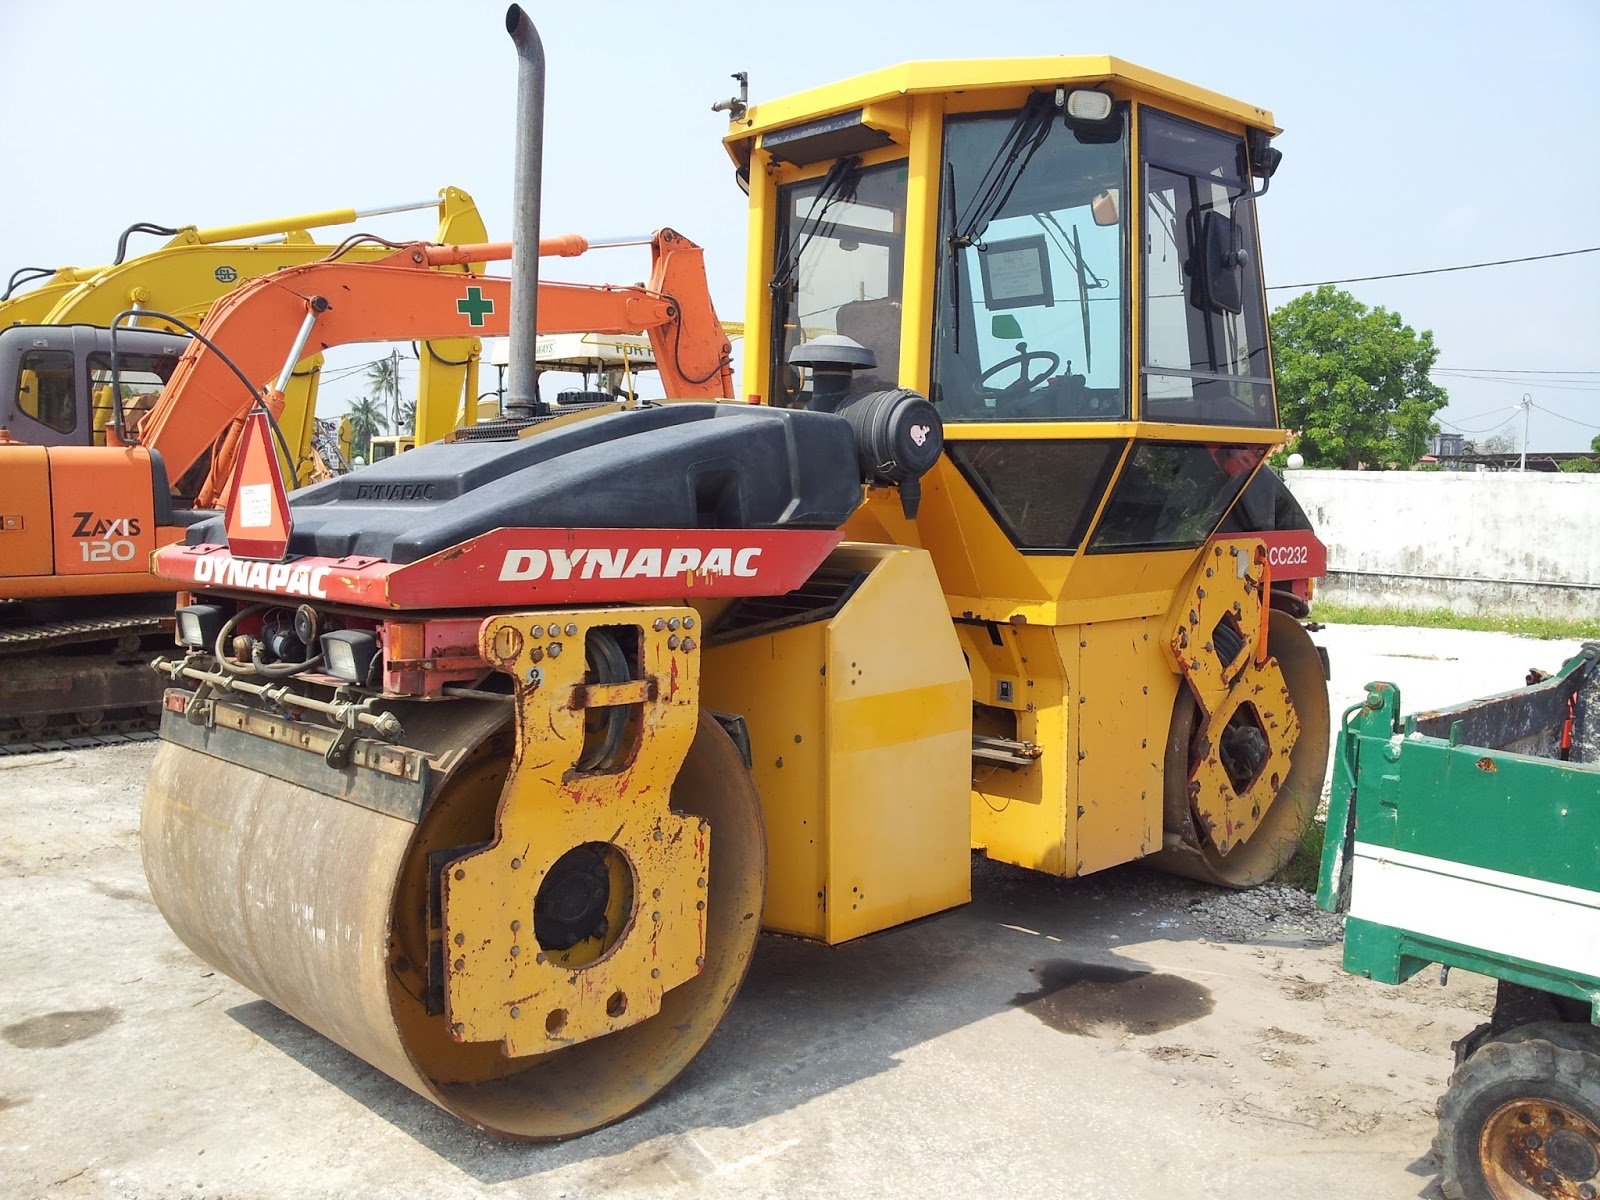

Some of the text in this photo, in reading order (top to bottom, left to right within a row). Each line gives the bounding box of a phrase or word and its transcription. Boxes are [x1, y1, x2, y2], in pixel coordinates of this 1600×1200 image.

[356, 483, 435, 500] DYNAPAC
[80, 540, 135, 561] 120
[1269, 546, 1308, 566] CC232
[498, 548, 762, 581] DYNAPAC
[193, 555, 332, 598] DYNAPAC
